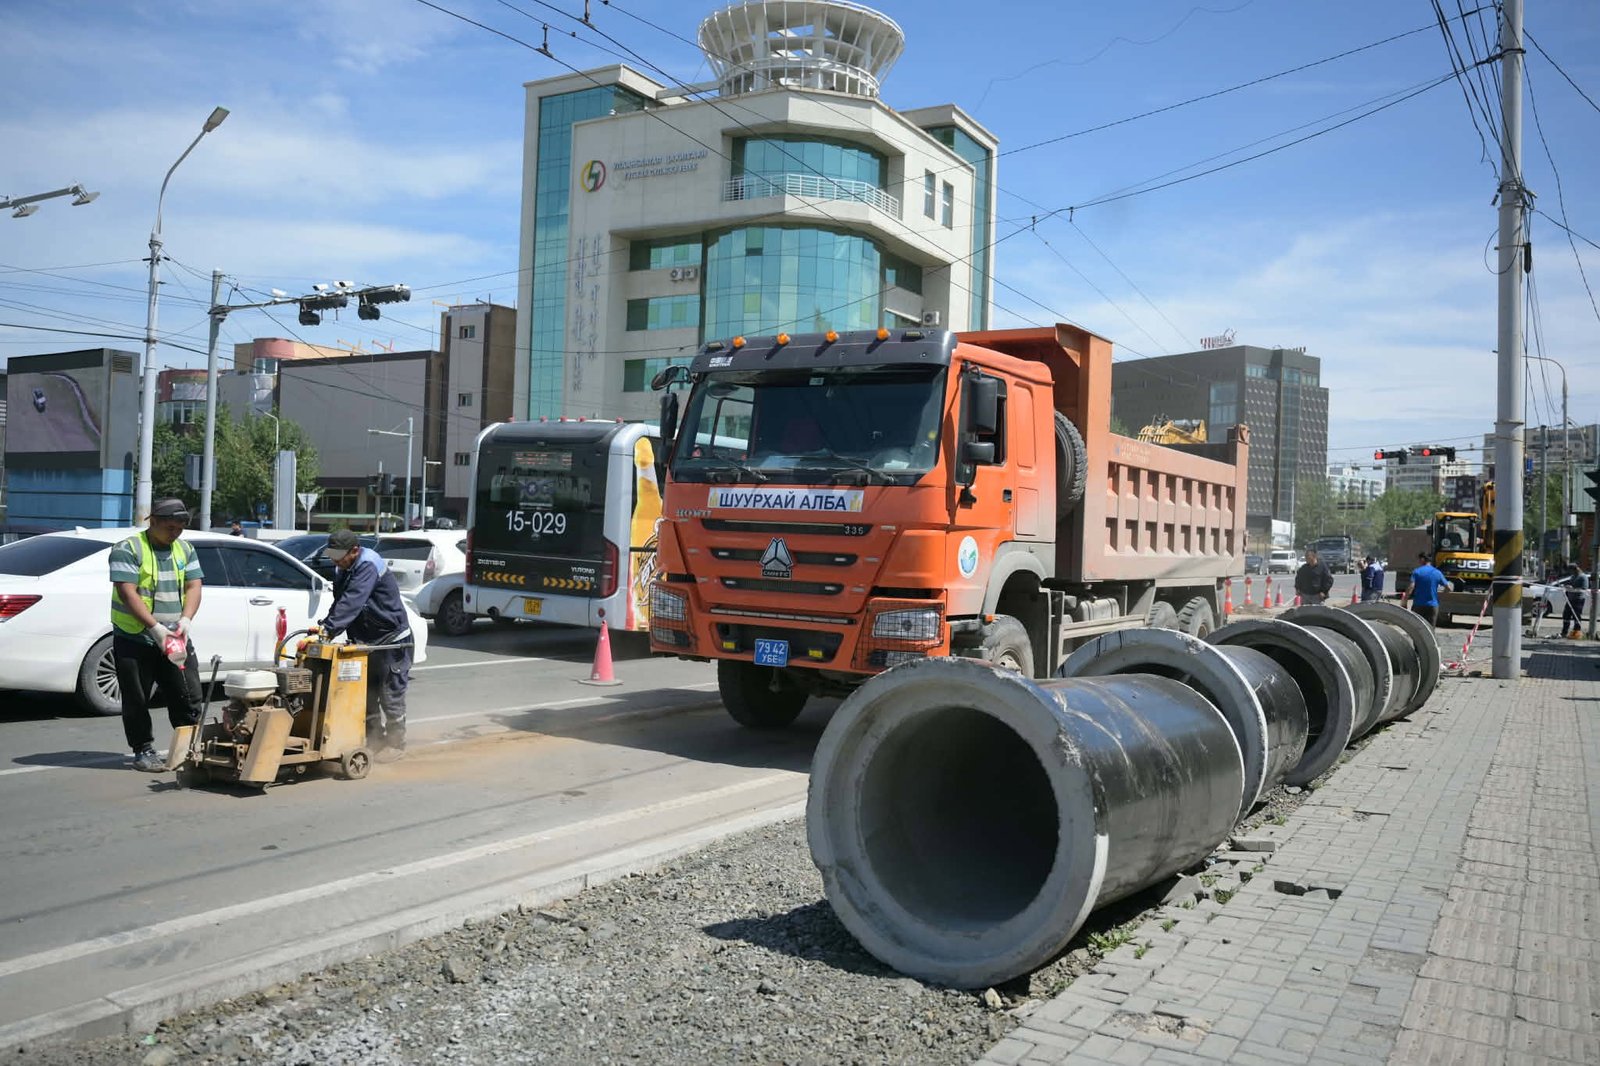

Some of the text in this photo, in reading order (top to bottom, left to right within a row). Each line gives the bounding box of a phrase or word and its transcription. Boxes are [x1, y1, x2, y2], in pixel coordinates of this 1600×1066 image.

[719, 491, 847, 511] ШУУРХАЙ АЛБА
[505, 510, 567, 534] 15-029
[844, 525, 864, 535] 336
[570, 566, 596, 574] YUTONG
[1457, 559, 1491, 570] JCB
